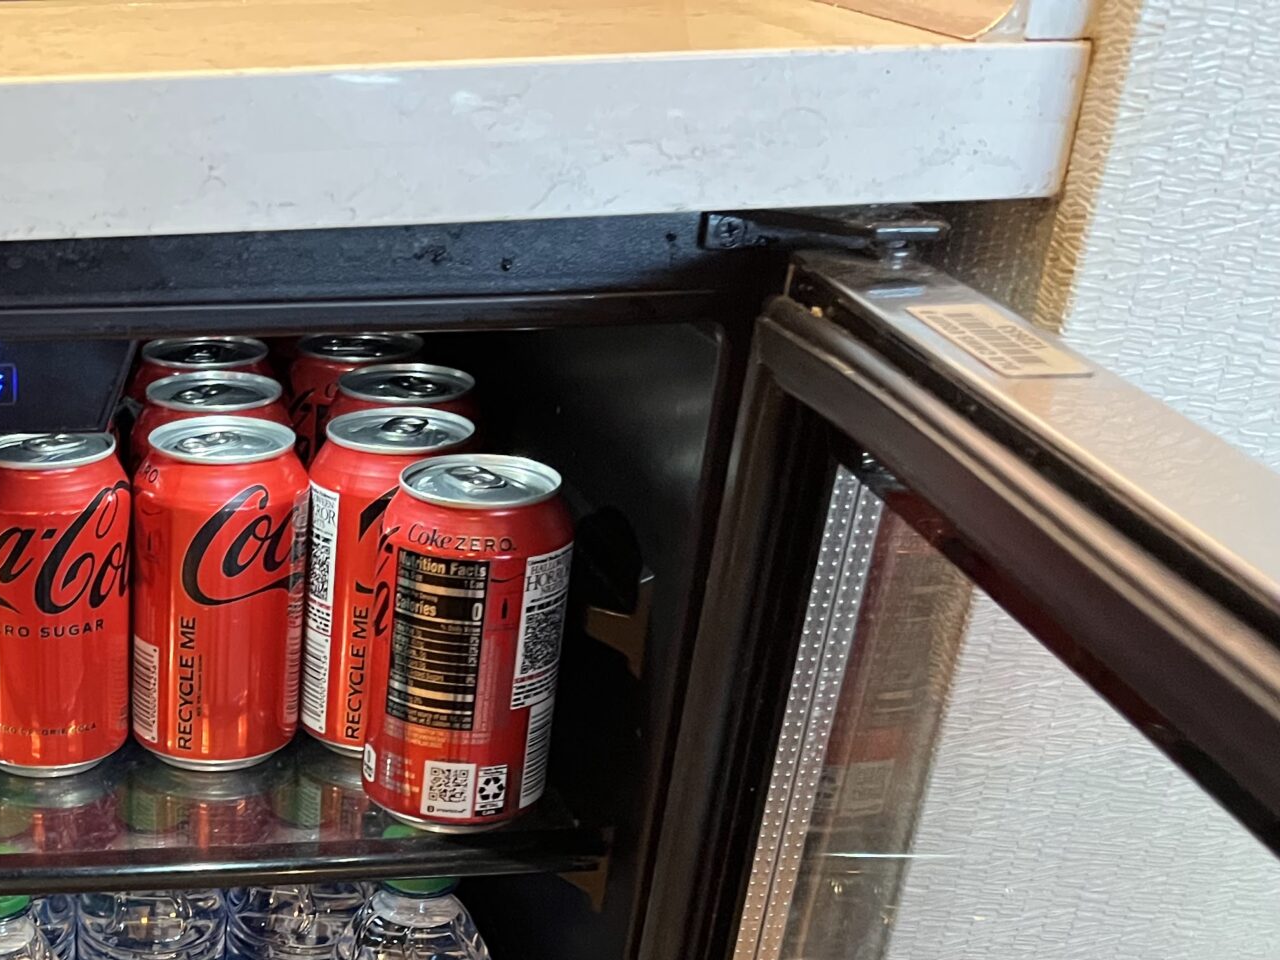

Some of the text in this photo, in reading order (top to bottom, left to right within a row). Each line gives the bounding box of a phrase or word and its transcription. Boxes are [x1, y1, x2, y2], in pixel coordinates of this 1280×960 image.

[408, 523, 514, 551] Coke ZERO
[450, 561, 487, 577] Facts
[396, 593, 437, 616] Calories
[472, 602, 484, 621] 0
[40, 619, 104, 638] SUGAR
[177, 616, 197, 751] RECYCLE ME
[345, 605, 369, 740] RECYCLE ME
